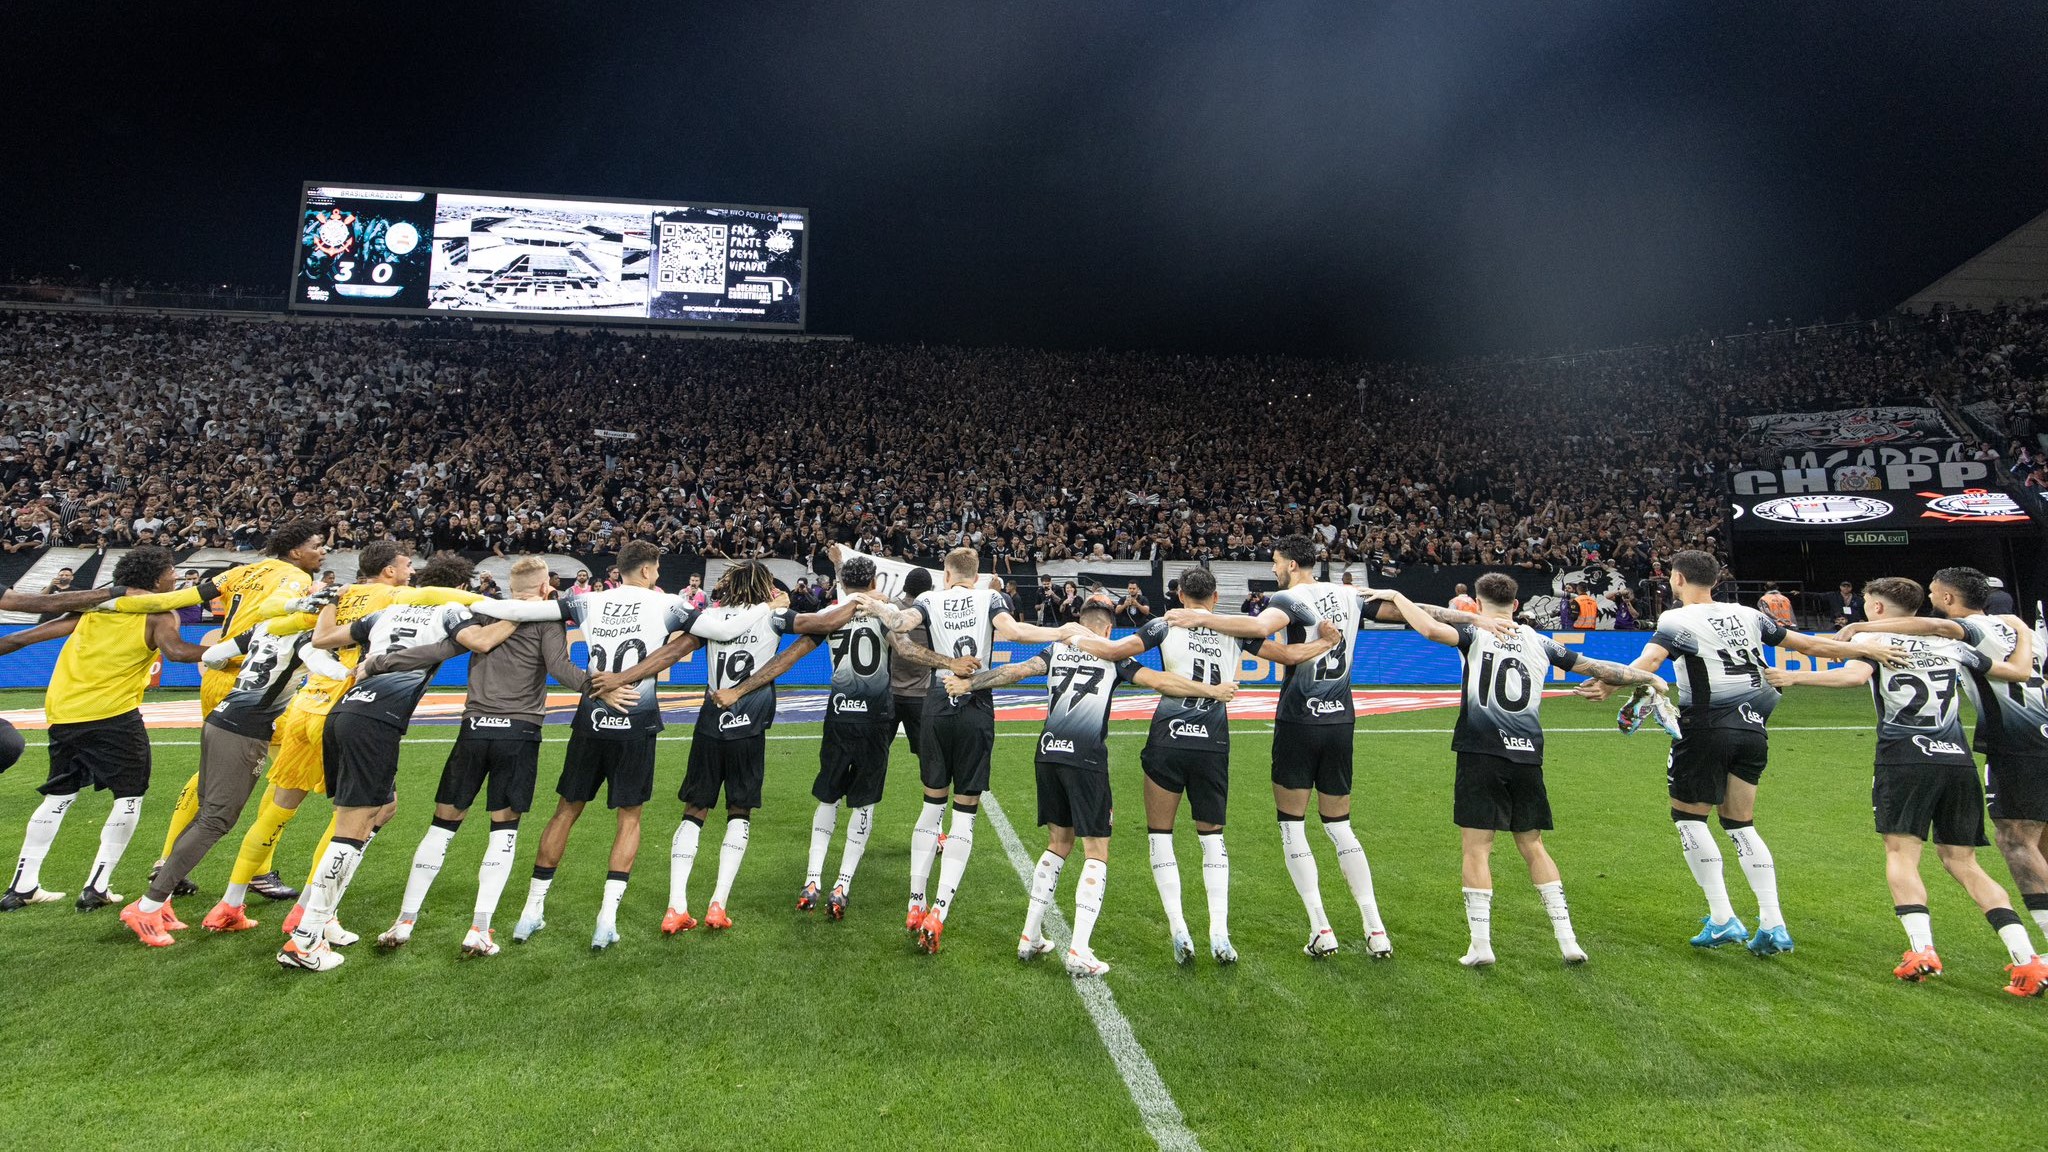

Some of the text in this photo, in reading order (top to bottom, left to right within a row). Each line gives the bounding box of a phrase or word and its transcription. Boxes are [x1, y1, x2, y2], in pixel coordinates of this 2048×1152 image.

[745, 211, 759, 219] POR
[730, 237, 761, 249] PARTE
[729, 248, 759, 260] DESSA
[334, 261, 393, 284] 3 0
[1847, 531, 1906, 543] SAÍDA EXIT
[603, 602, 641, 617] EZZE
[943, 596, 974, 611] EZZE
[221, 593, 243, 639] 1
[601, 616, 638, 625] SEGUROS
[944, 608, 975, 619] SEGUROS
[829, 627, 881, 678] 70
[1916, 656, 1950, 669] BIDON
[1478, 650, 1532, 714] 10
[1049, 665, 1106, 716] 77
[1887, 669, 1957, 729] 27
[857, 808, 869, 835] ksk
[325, 850, 348, 880] ksk
